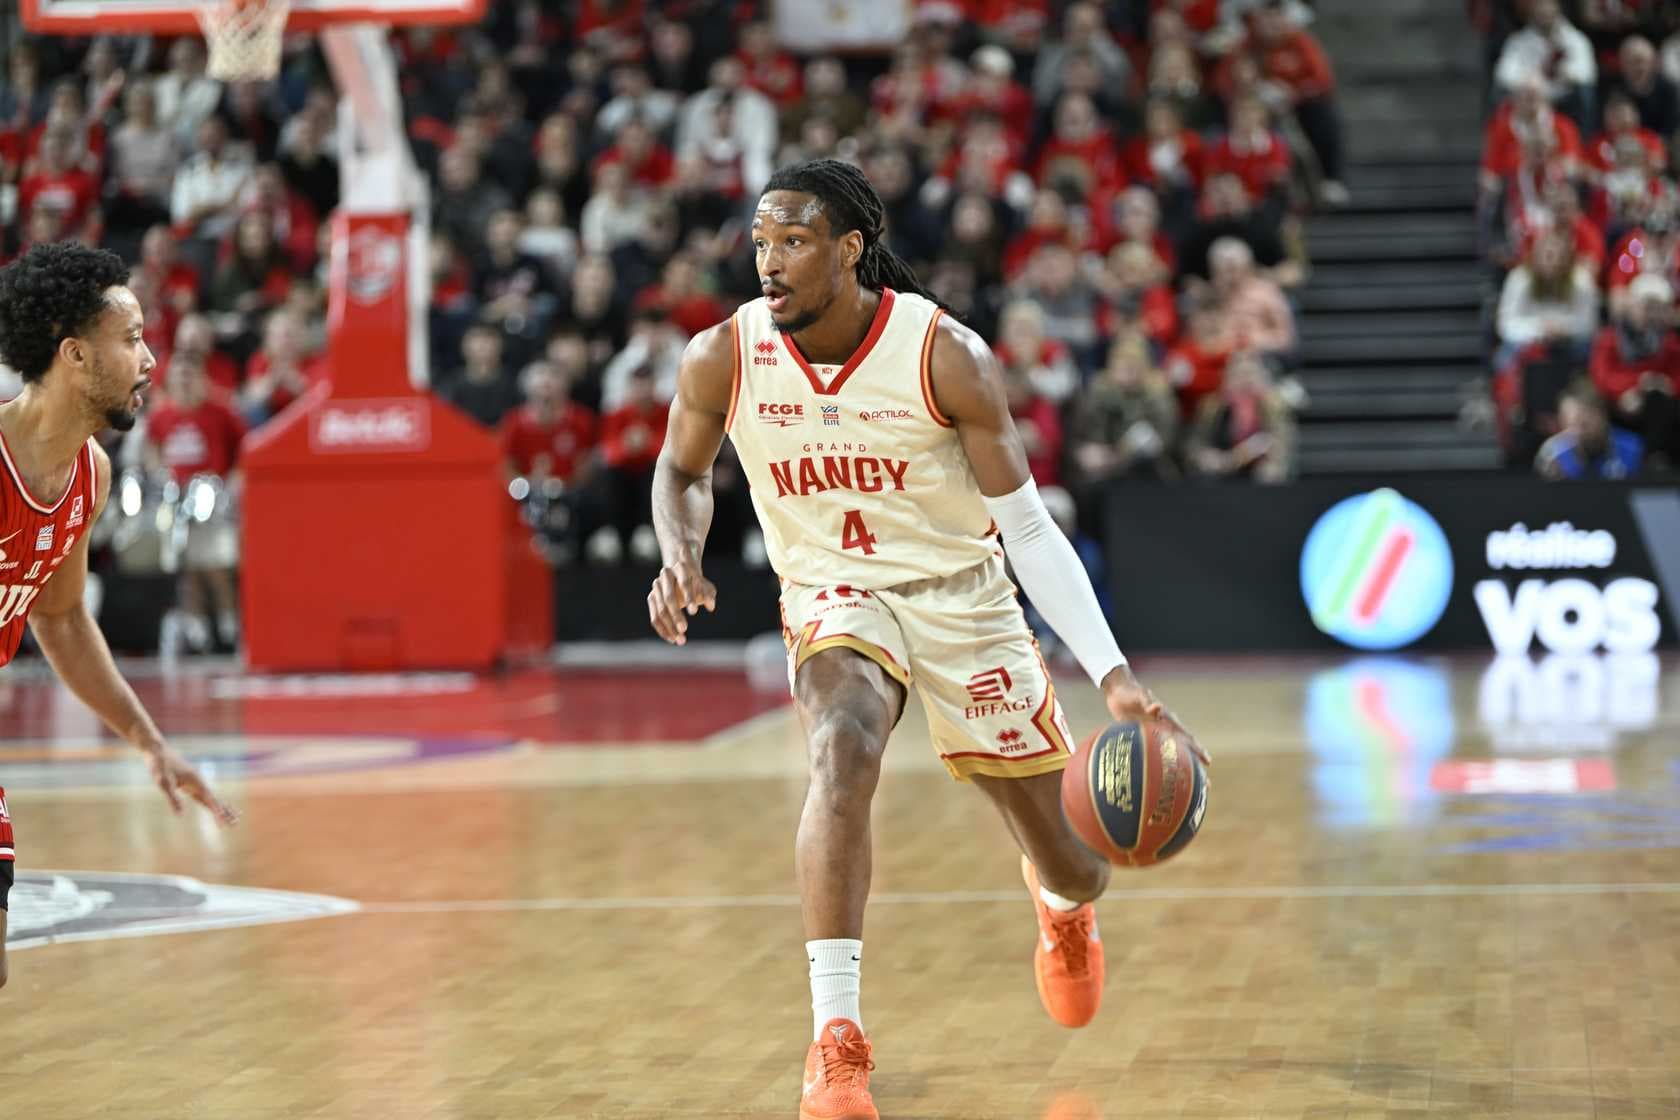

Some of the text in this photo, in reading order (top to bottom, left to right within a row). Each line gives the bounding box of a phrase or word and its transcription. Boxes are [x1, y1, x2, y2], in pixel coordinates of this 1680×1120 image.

[754, 356, 777, 366] errea
[758, 403, 804, 415] FCGE
[803, 443, 867, 452] GRAND
[768, 456, 910, 497] NANCY
[842, 509, 877, 555] 4
[964, 695, 1034, 720] EIFFAGE
[999, 741, 1028, 753] errea
